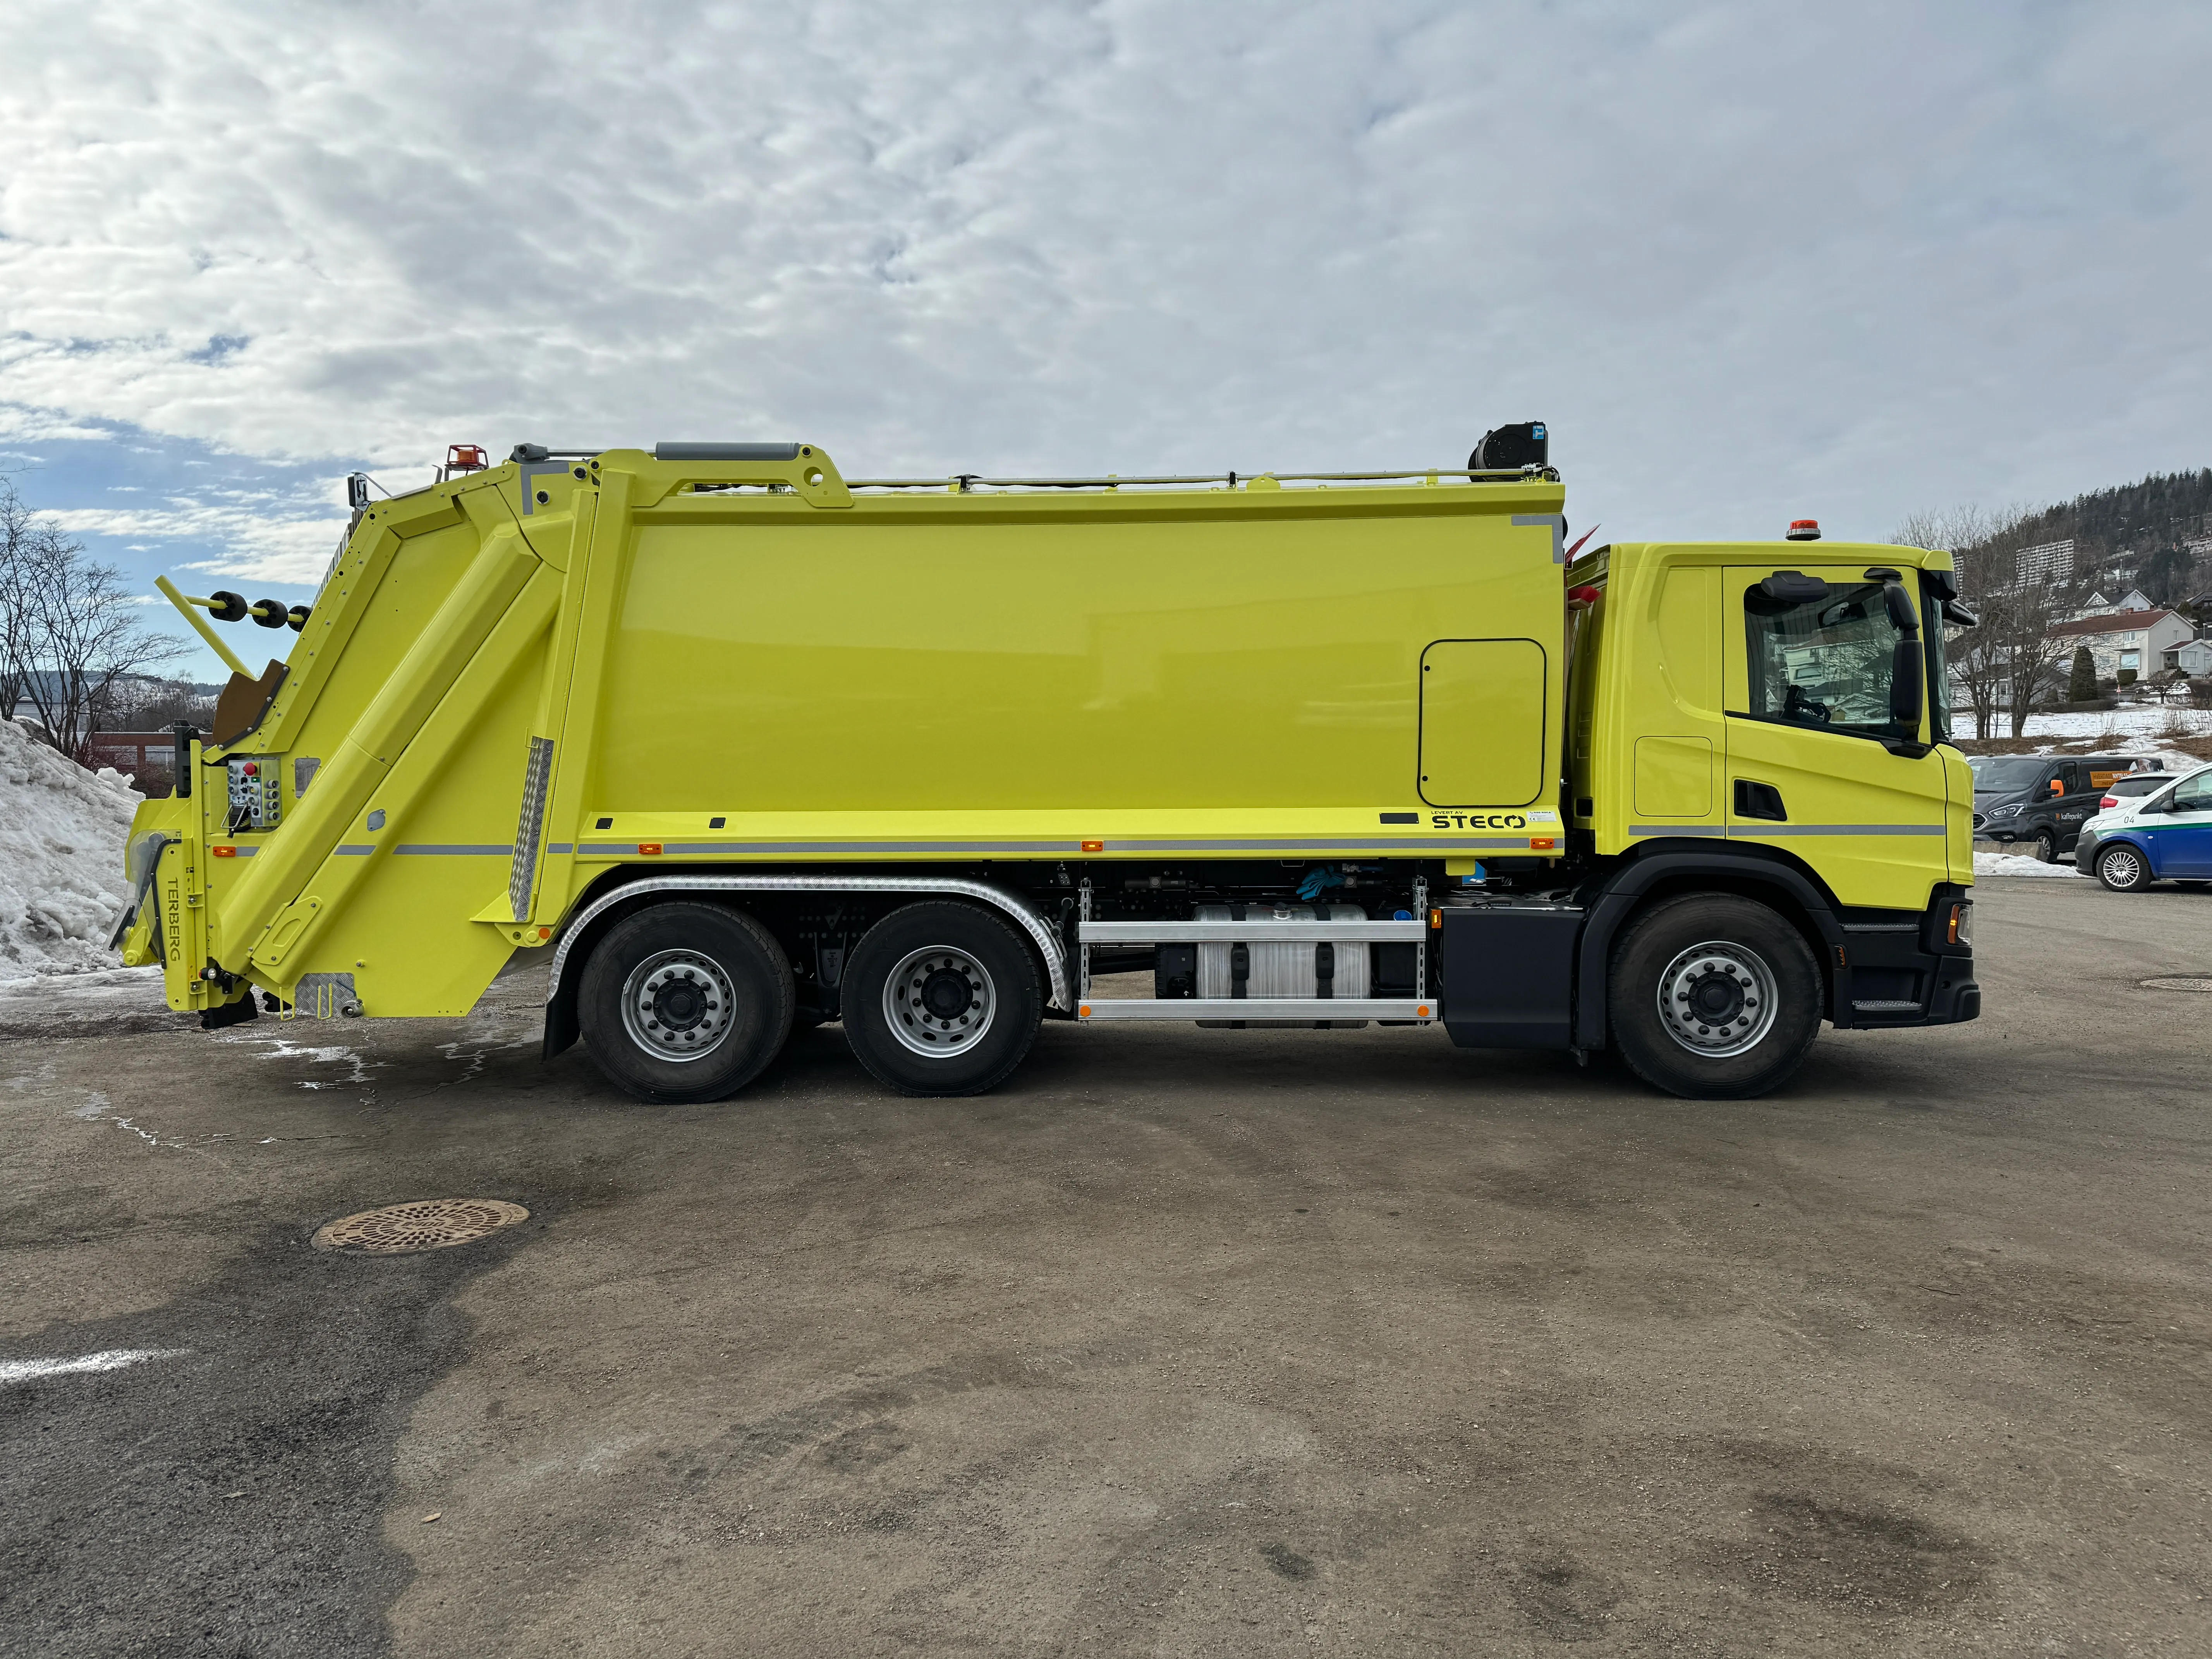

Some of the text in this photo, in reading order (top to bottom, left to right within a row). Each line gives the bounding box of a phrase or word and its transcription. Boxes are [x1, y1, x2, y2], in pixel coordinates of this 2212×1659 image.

[1432, 814, 1526, 829] STECO
[2061, 812, 2082, 821] kaffepunkt
[168, 876, 180, 962] TERBERG
